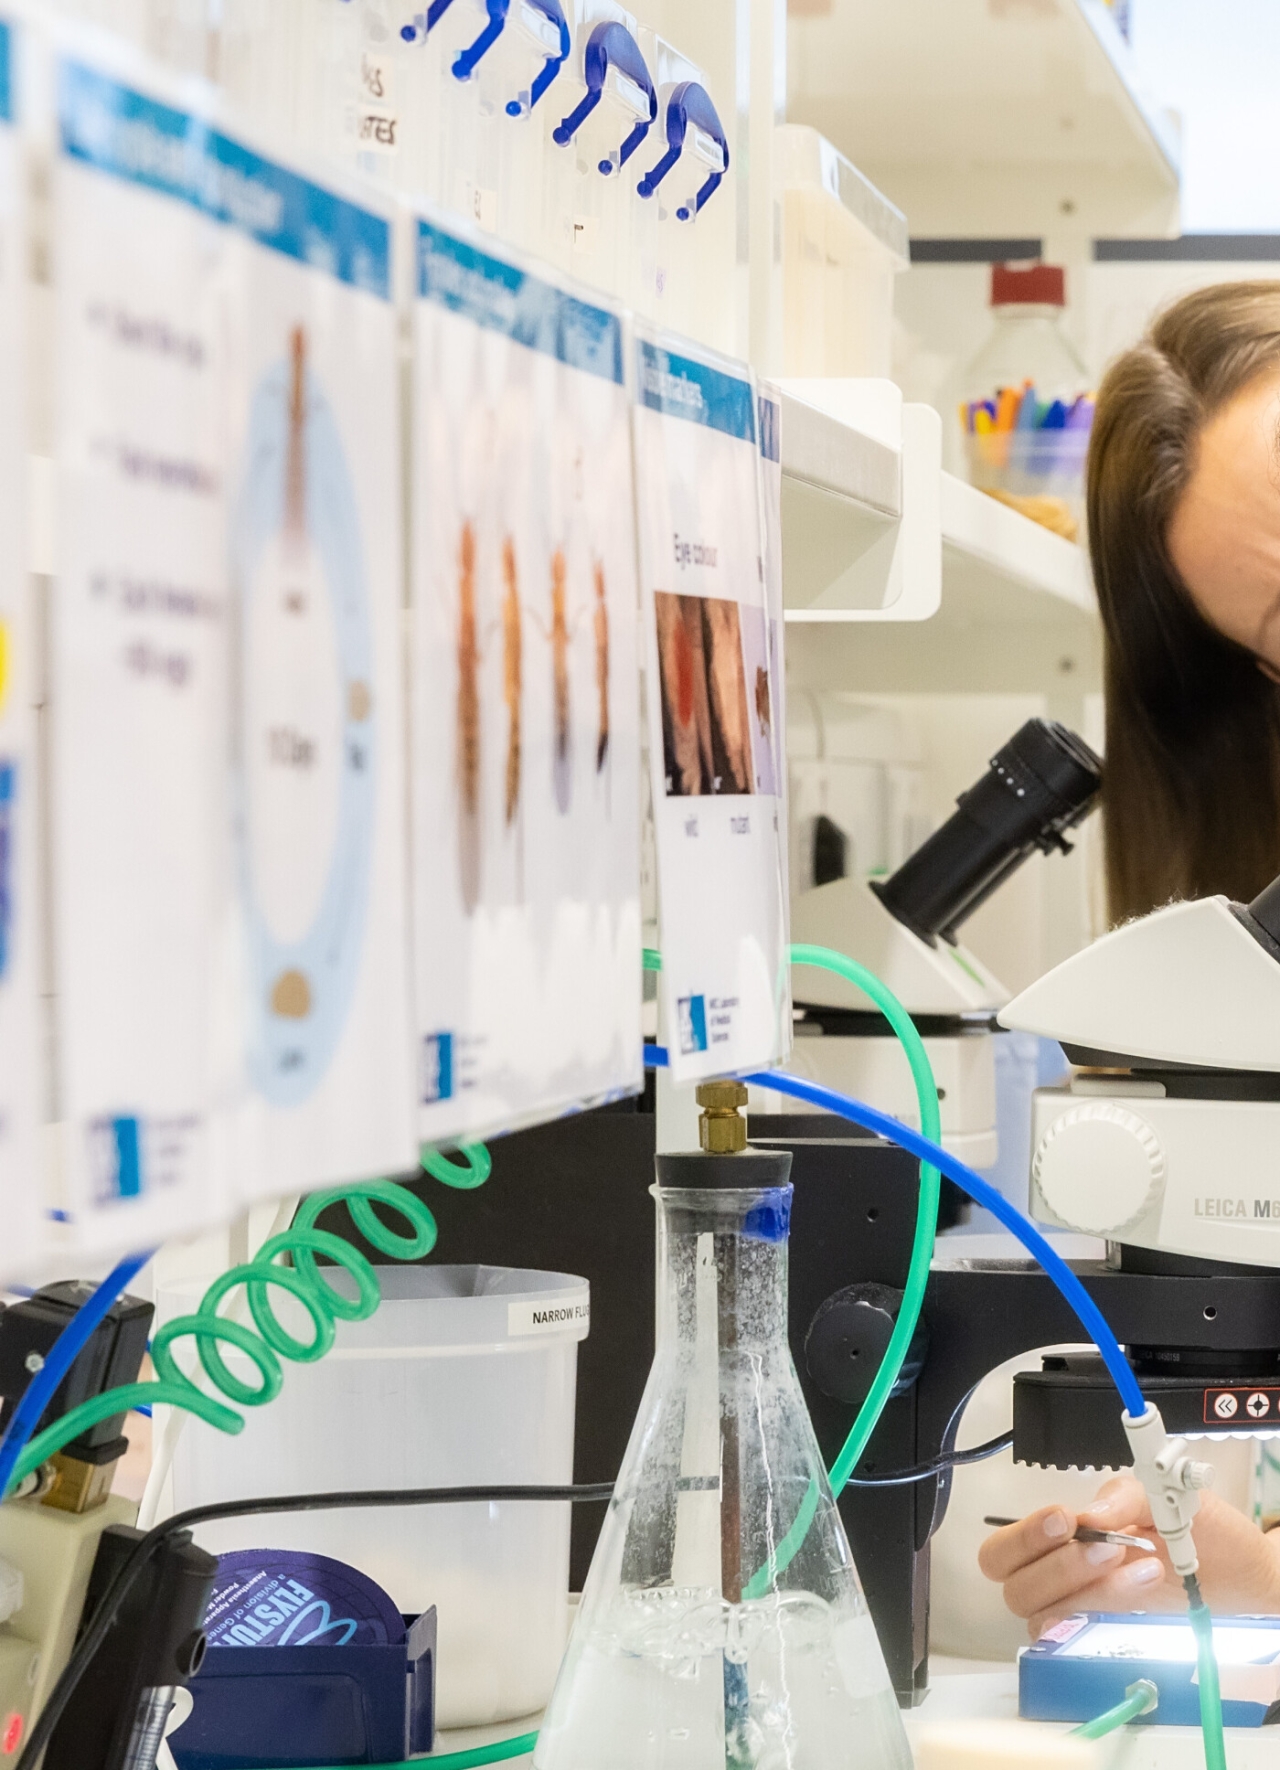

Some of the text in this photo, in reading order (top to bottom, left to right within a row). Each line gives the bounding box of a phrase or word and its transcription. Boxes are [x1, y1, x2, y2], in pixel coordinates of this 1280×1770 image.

[1194, 1198, 1248, 1217] LEICA
[532, 1307, 574, 1325] NARROW
[277, 1573, 286, 1581] a
[214, 1582, 240, 1604] Powder
[229, 1570, 267, 1604] Anaesthesia
[243, 1580, 279, 1610] division
[233, 1608, 245, 1619] of
